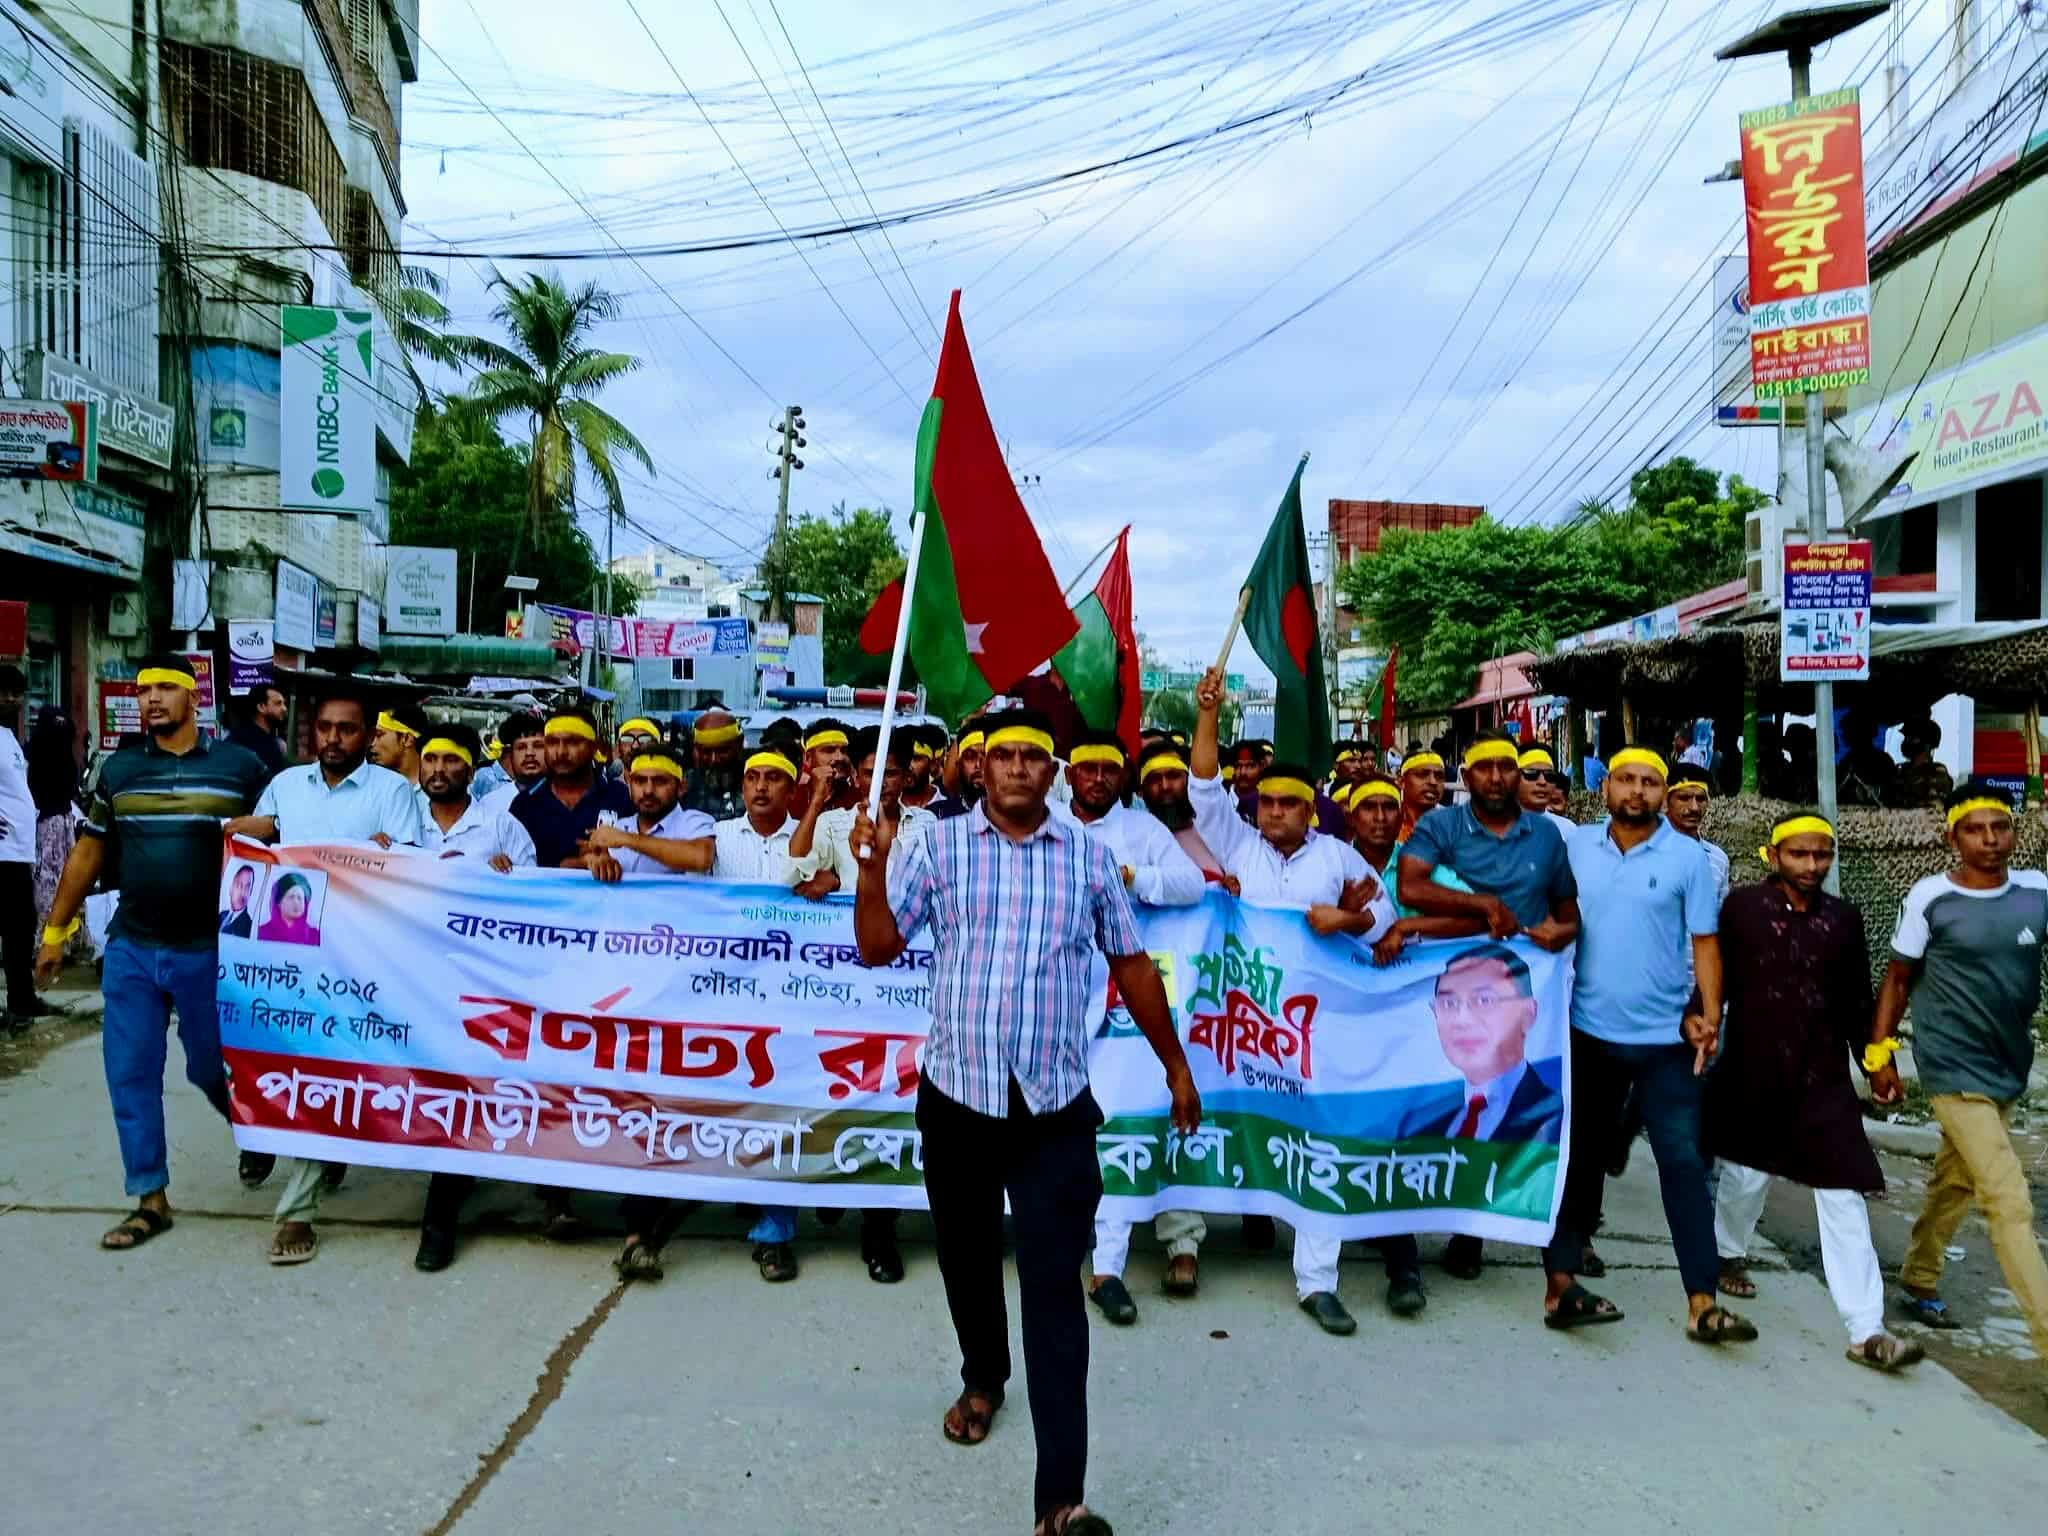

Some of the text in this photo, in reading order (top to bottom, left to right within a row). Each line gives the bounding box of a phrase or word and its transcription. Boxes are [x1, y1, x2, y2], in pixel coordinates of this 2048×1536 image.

[1791, 297, 1818, 321] ভর্তি
[1823, 290, 1865, 319] কোচিং
[1753, 321, 1866, 356] গাইবান্ধা
[322, 345, 338, 394] BANK
[1756, 370, 1869, 399] 01813-000202
[317, 395, 339, 464] NRBC
[1937, 382, 2043, 450] AZA
[1934, 448, 1962, 471] Hotel
[1971, 423, 2041, 458] Restaurant
[447, 912, 599, 953] বাংলাদেশ
[604, 924, 793, 963] জাতীয়তাবাদী
[233, 961, 305, 999] আগস্ট,
[317, 973, 379, 1004] ২০২৫
[690, 968, 767, 1002] গৌরব,
[875, 983, 932, 1010] সংগ্রা
[1185, 933, 1284, 1016] প্রতিষ্ঠা
[251, 998, 317, 1036] বিকাল
[322, 1015, 339, 1038] ৫
[349, 1011, 412, 1048] ঘটিকা
[459, 986, 782, 1090] বর্ণাঢ্য
[1188, 988, 1319, 1081] বার্ষিকী
[256, 1068, 554, 1152] পলাশবাড়ী
[563, 1086, 814, 1175] উপজেলা
[1267, 1131, 1469, 1211] গাইবান্ধা
